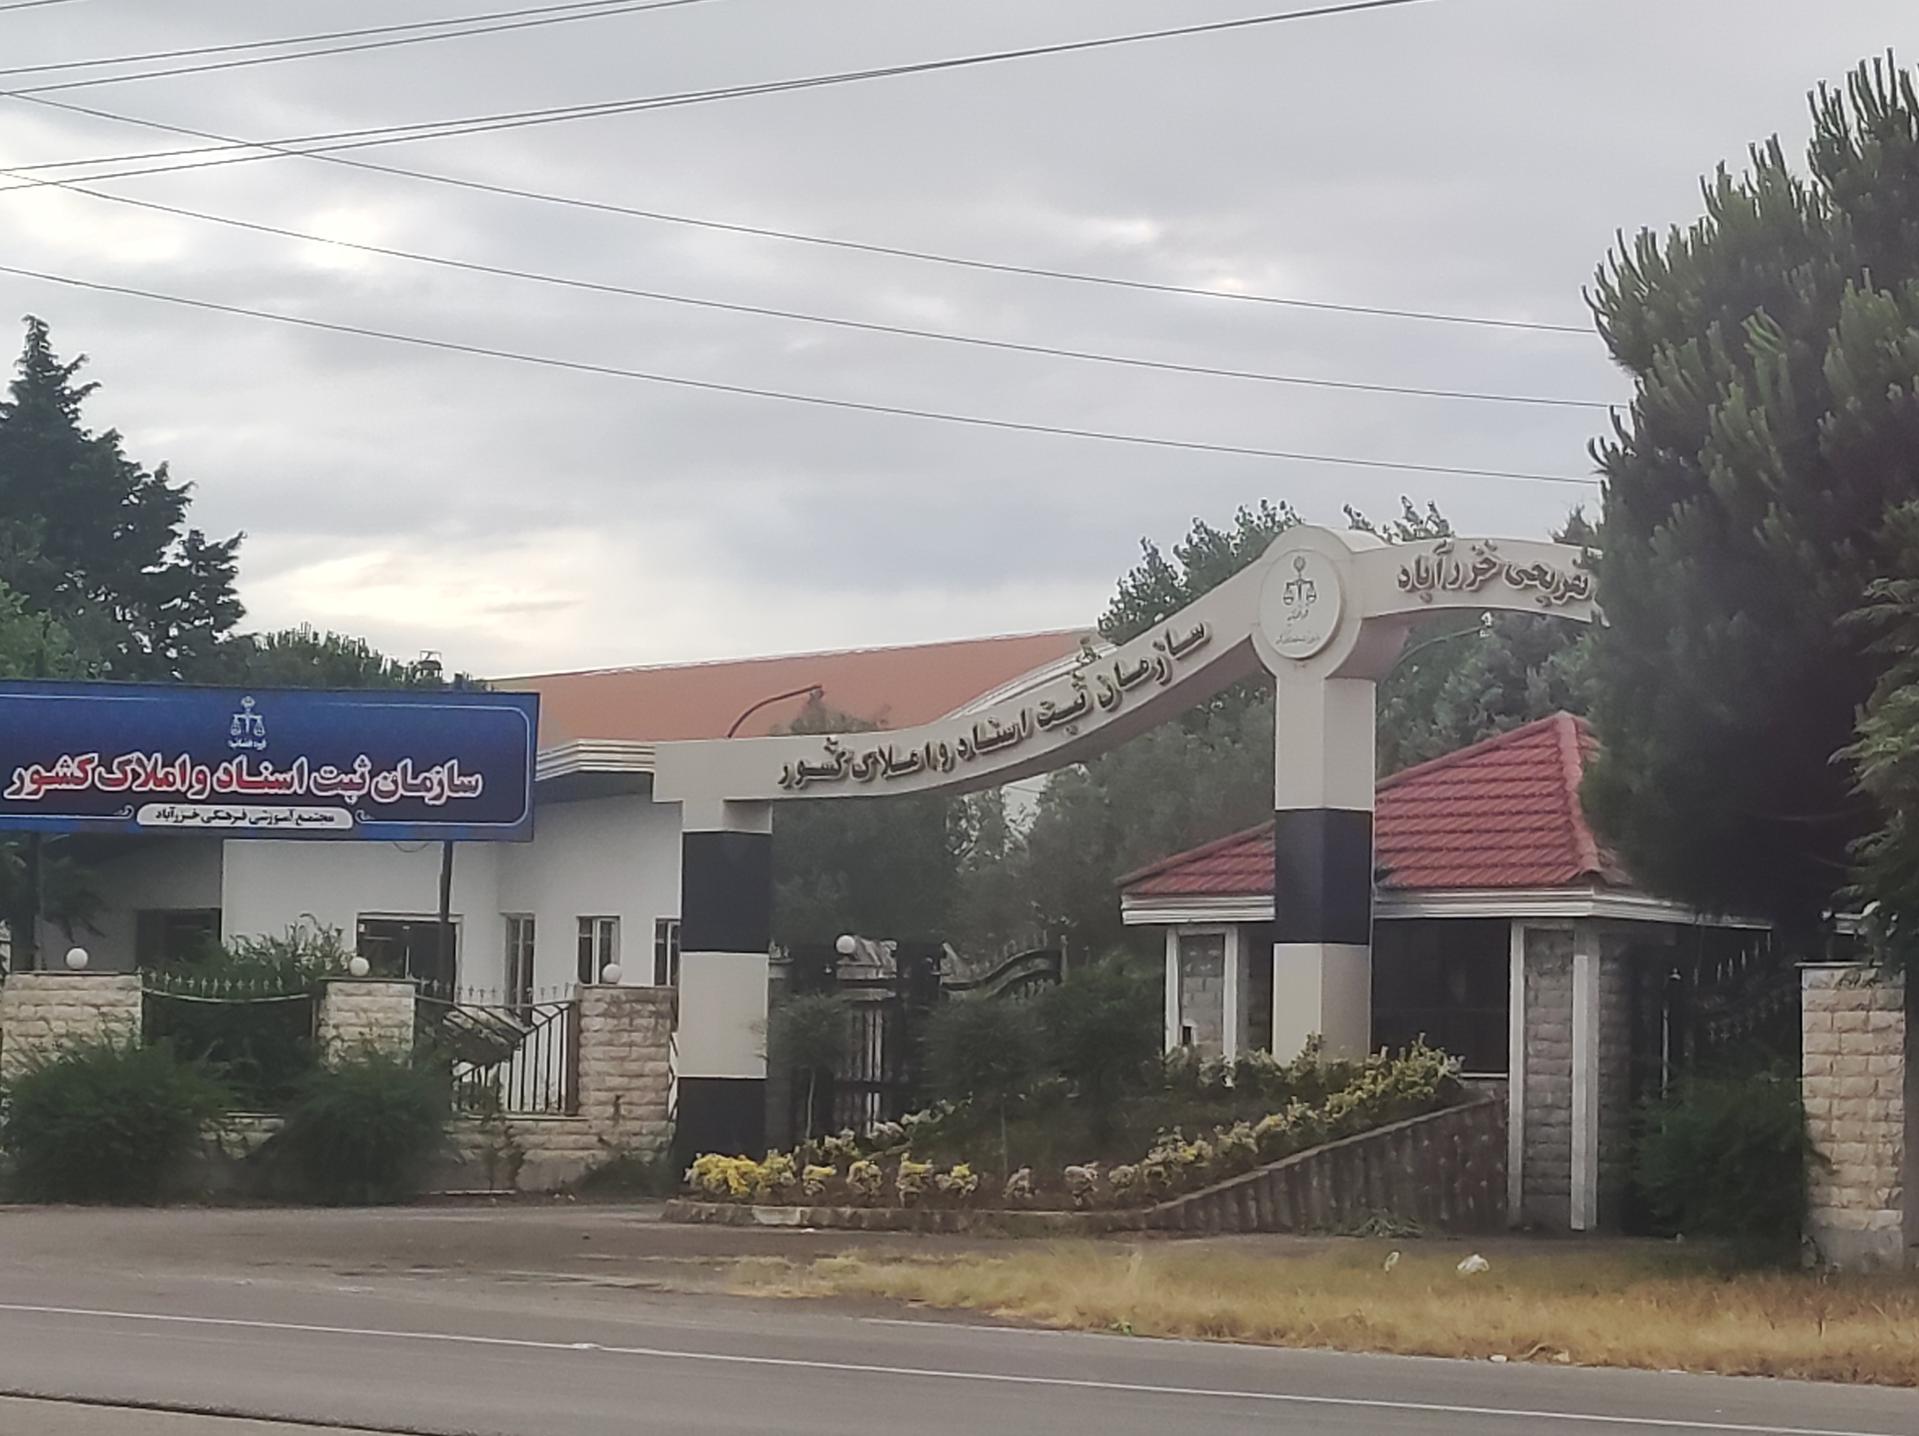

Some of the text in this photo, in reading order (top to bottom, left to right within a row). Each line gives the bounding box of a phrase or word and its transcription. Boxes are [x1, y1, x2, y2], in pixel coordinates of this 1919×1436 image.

[778, 620, 1211, 788] سازمان ثبت اسناد و املاک کشور
[4, 752, 483, 806] سازمان ثبت اسناد و املاک کشور
[201, 808, 247, 826] فرهنگی
[296, 811, 336, 826] مجتمع
